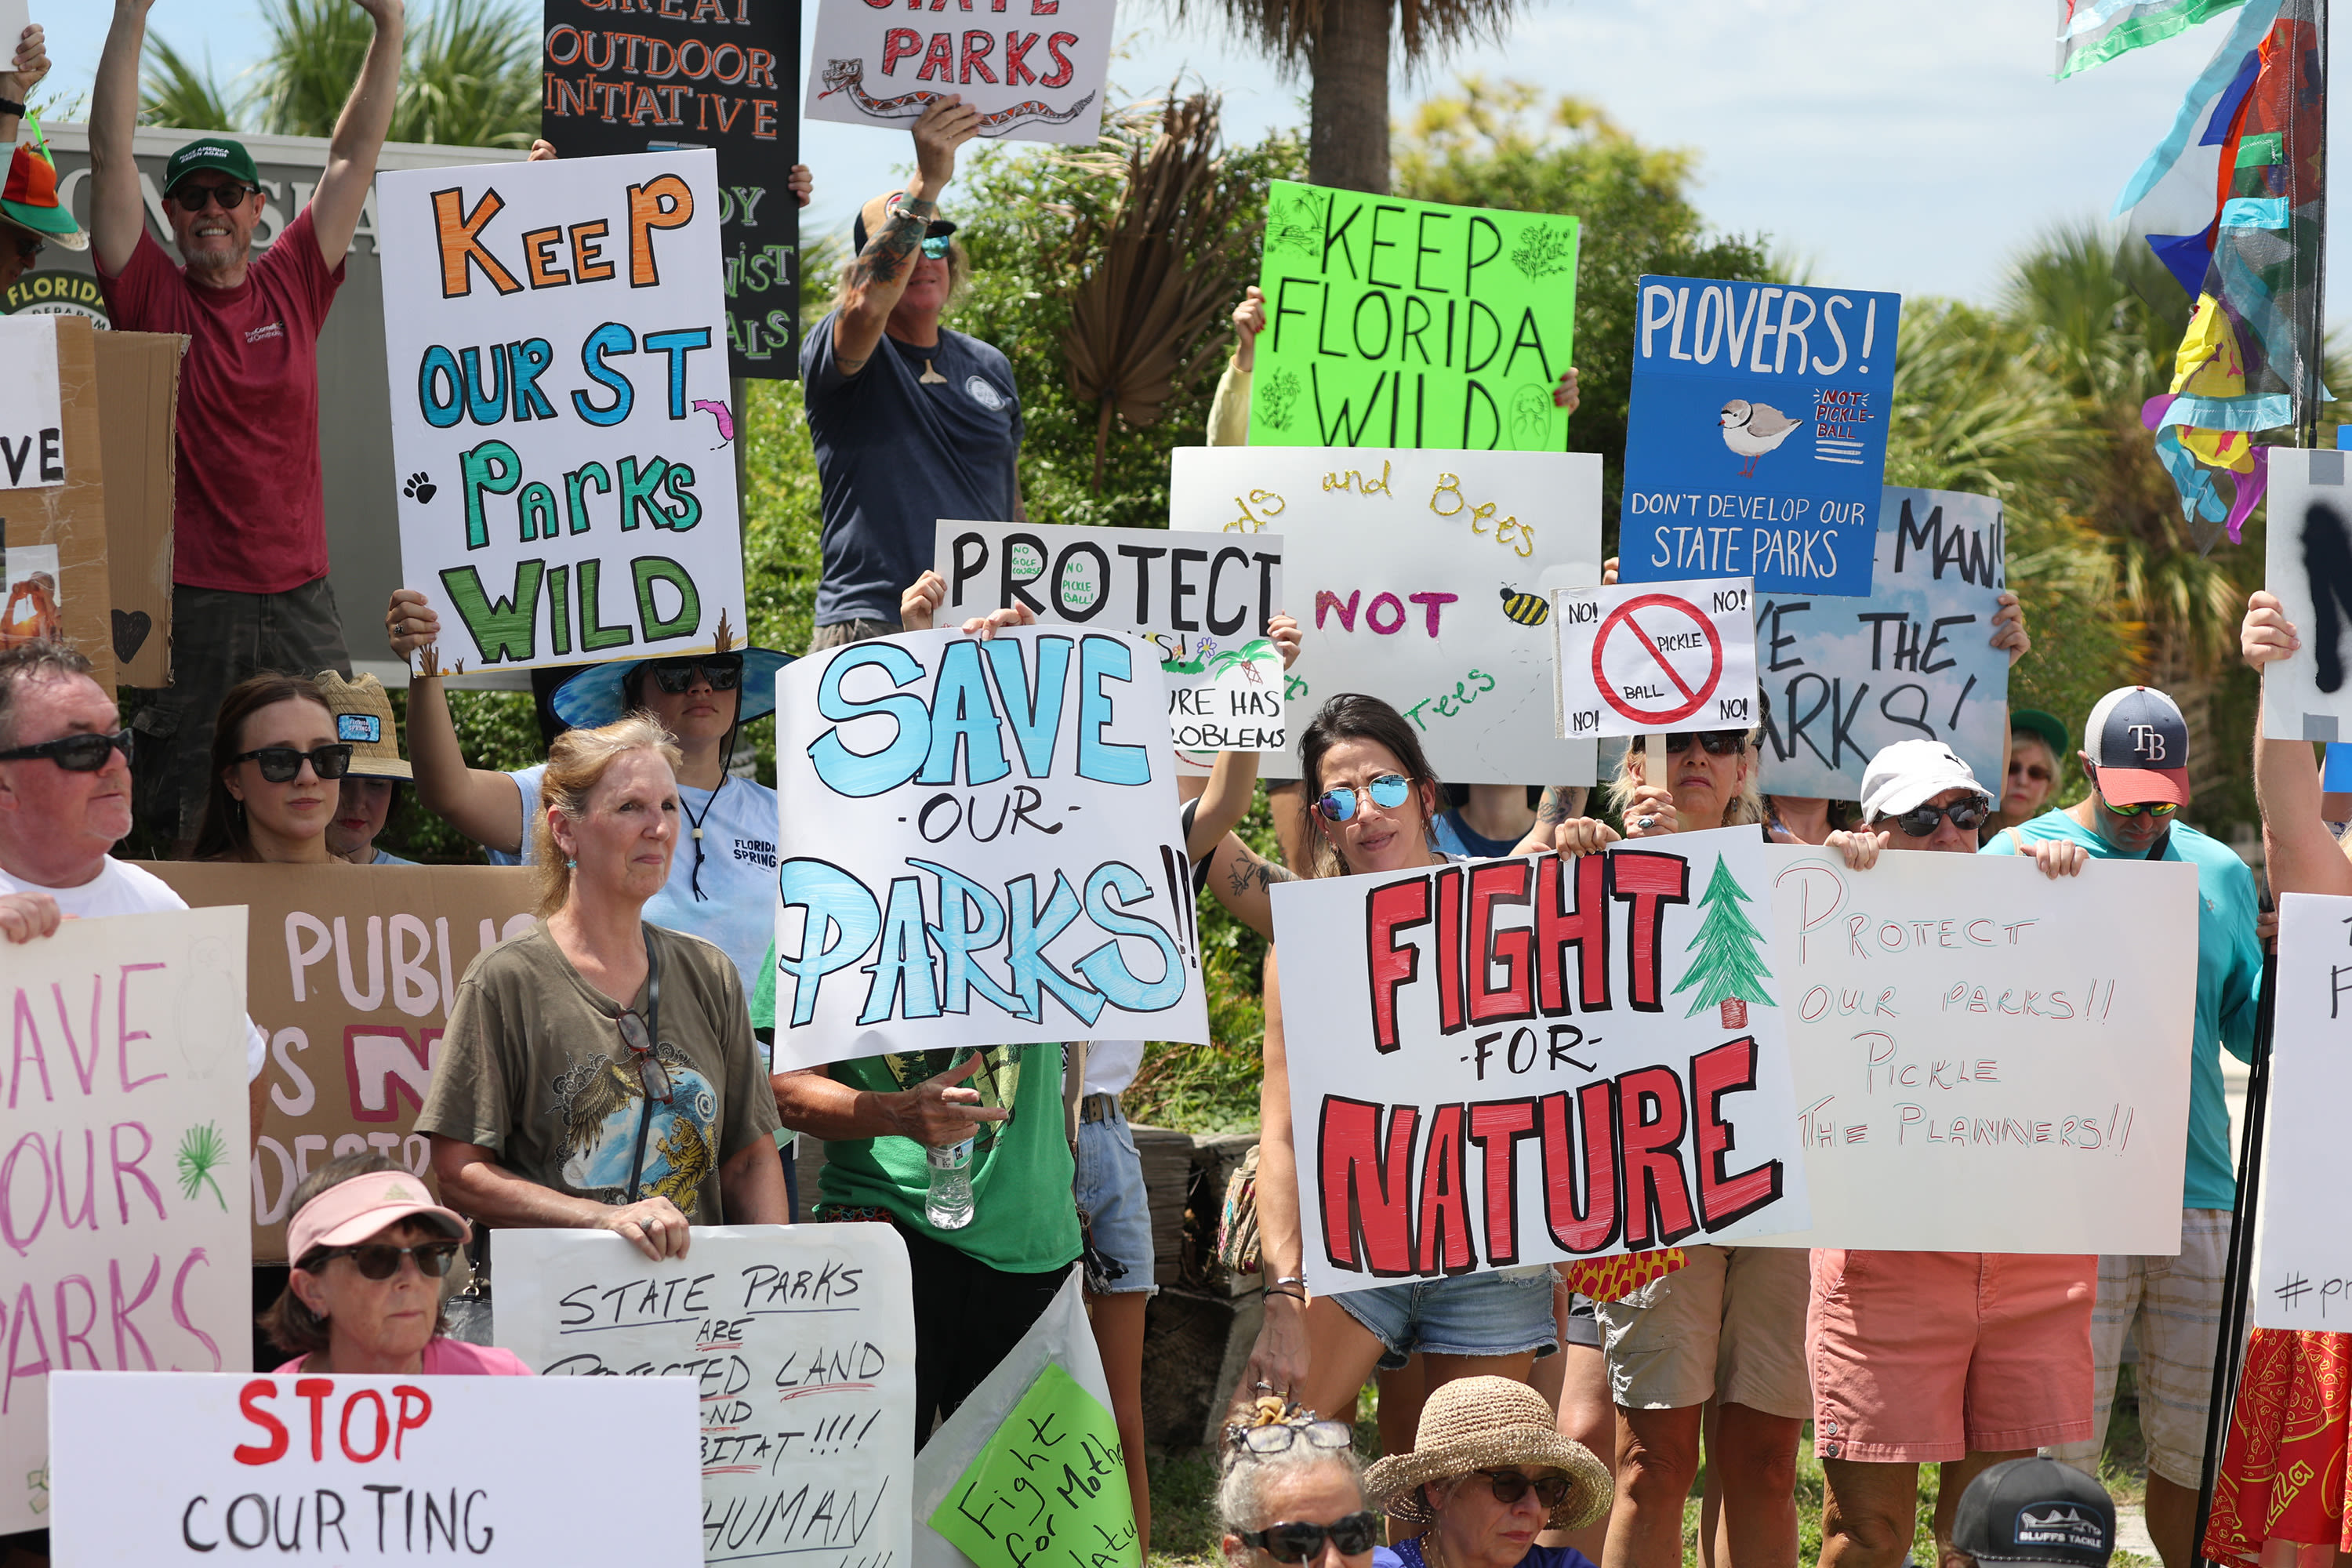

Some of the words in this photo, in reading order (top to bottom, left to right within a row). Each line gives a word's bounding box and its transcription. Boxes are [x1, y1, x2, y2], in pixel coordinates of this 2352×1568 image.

[546, 24, 778, 89] OUTDOOR
[881, 27, 1080, 89] PARKS
[1322, 192, 1503, 297] KEEP
[1274, 277, 1553, 383] FLORIDA
[1642, 285, 1876, 376] PLOVERS!
[418, 337, 558, 428] OUR
[570, 321, 712, 427] ST
[1822, 389, 1864, 406] NOT
[1817, 423, 1857, 439] BALL
[1323, 459, 1392, 498] and
[1429, 472, 1535, 557] Bees
[1632, 493, 1701, 514] DON'T
[1708, 495, 1809, 522] DEVELOP
[1820, 500, 1866, 526] OUR
[1012, 557, 1036, 566] GOLF
[1066, 562, 1083, 573] NO
[1652, 526, 1743, 572] STATE
[1752, 528, 1838, 579] PARKS
[438, 555, 701, 663] WILD
[952, 532, 1282, 637] PROTECT
[1062, 579, 1092, 592] PICKLE
[1064, 592, 1094, 604] BALL!
[1315, 589, 1459, 639] NOT
[1569, 602, 1599, 624] NO!
[1714, 589, 1747, 613] NO!
[1657, 633, 1703, 652] PICKLE
[1857, 612, 1976, 674] THE
[807, 633, 1152, 798] SAVE
[1230, 690, 1280, 717] HAS
[1573, 710, 1600, 731] NO!
[1623, 684, 1664, 699] BALL
[1720, 698, 1748, 720] NO!
[2128, 724, 2167, 762] TB
[733, 848, 779, 868] SPRING
[734, 839, 776, 854] FLORIDA
[779, 844, 1199, 1029] PARKS!!
[1773, 858, 2040, 966] PROTECT
[1366, 848, 1690, 1054] FIGHT
[1798, 985, 1900, 1023] OUR
[1942, 978, 2115, 1025] PARKS!!
[0, 962, 169, 1110] AVE
[1851, 1029, 2002, 1095] PICKLE
[1798, 1094, 1869, 1151] THE
[1893, 1102, 2134, 1157] PLANNERS!!
[1317, 1036, 1784, 1278] NATURE
[1, 1120, 169, 1257] OUR
[559, 1273, 716, 1326] STATE
[742, 1258, 863, 1310] PARKS
[0, 1246, 222, 1414] ARKS
[695, 1318, 755, 1342] ARE
[775, 1340, 886, 1387] LAND
[234, 1378, 433, 1466] STOP
[701, 1400, 753, 1425] ND
[957, 1413, 1067, 1540] Fight
[182, 1484, 494, 1555] COURTING
[703, 1475, 890, 1552] HUMAN
[2019, 1530, 2066, 1542] BLUFFS
[2068, 1535, 2103, 1549] TACKLE
